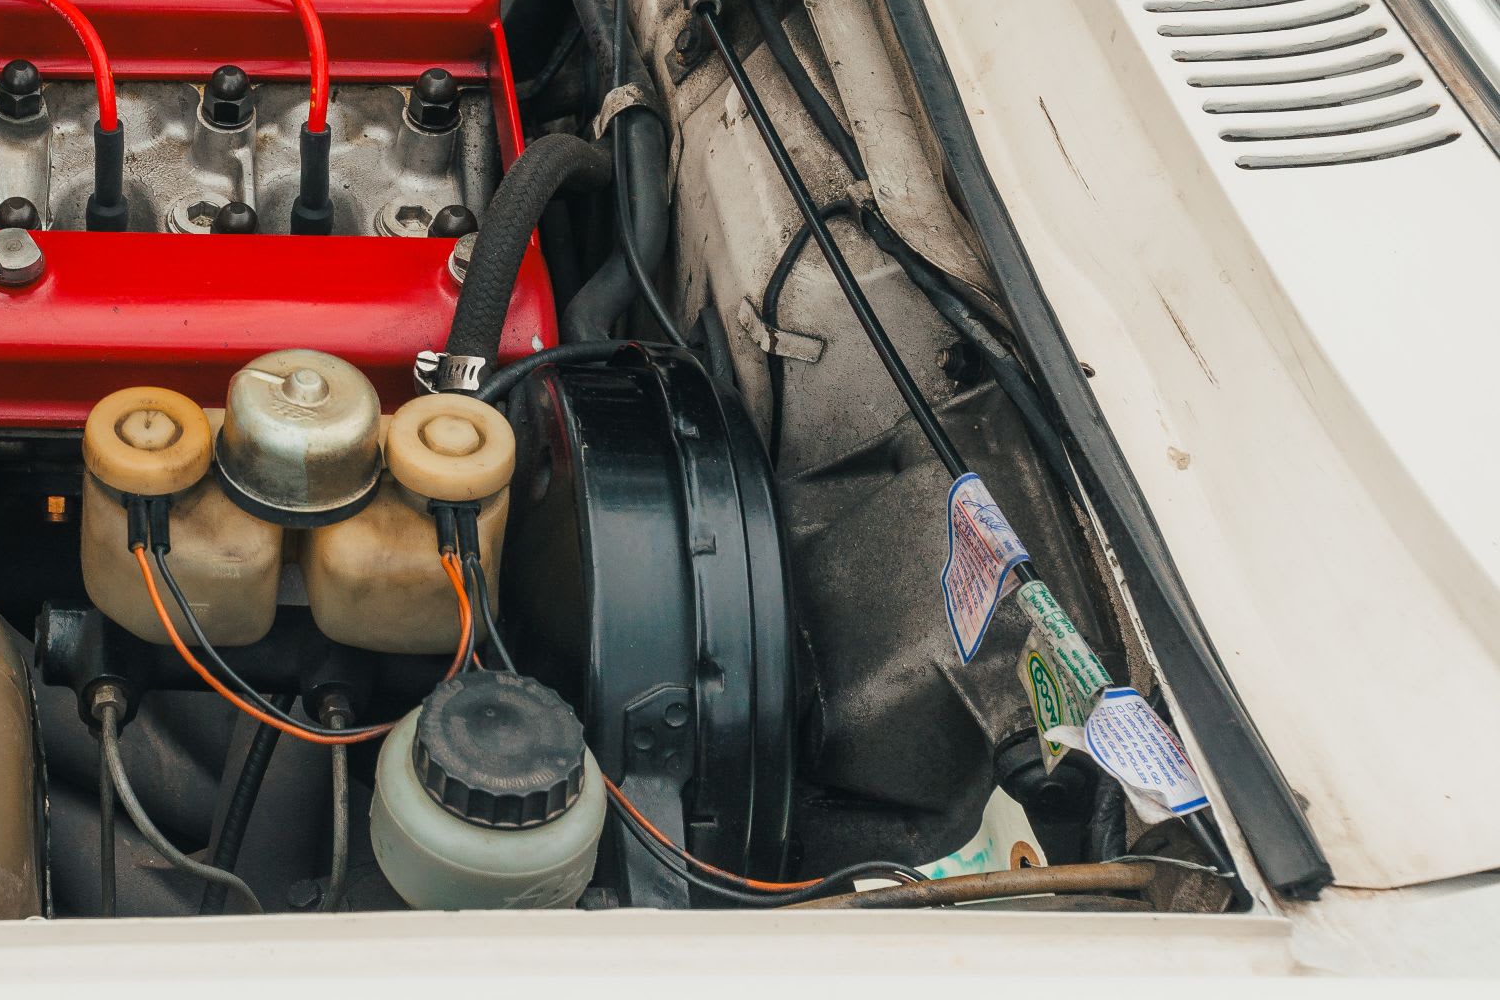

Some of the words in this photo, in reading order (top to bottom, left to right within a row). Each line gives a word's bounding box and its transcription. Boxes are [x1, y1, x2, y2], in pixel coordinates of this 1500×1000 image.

[1029, 593, 1047, 615] NON
[1039, 589, 1057, 609] NON
[1054, 644, 1094, 696] Changement
[1033, 667, 1058, 727] ACCO
[1092, 719, 1111, 739] LAVE
[1106, 740, 1128, 767] GLACE
[1102, 717, 1126, 745] FILTRE
[1123, 752, 1150, 783] POLLEN
[1112, 716, 1133, 739] FILTRE
[1134, 749, 1148, 763] AIR
[1149, 771, 1163, 784] GO
[1122, 713, 1148, 743] CIRCUIT
[1144, 744, 1155, 755] DE
[1163, 739, 1185, 766] HUILE
